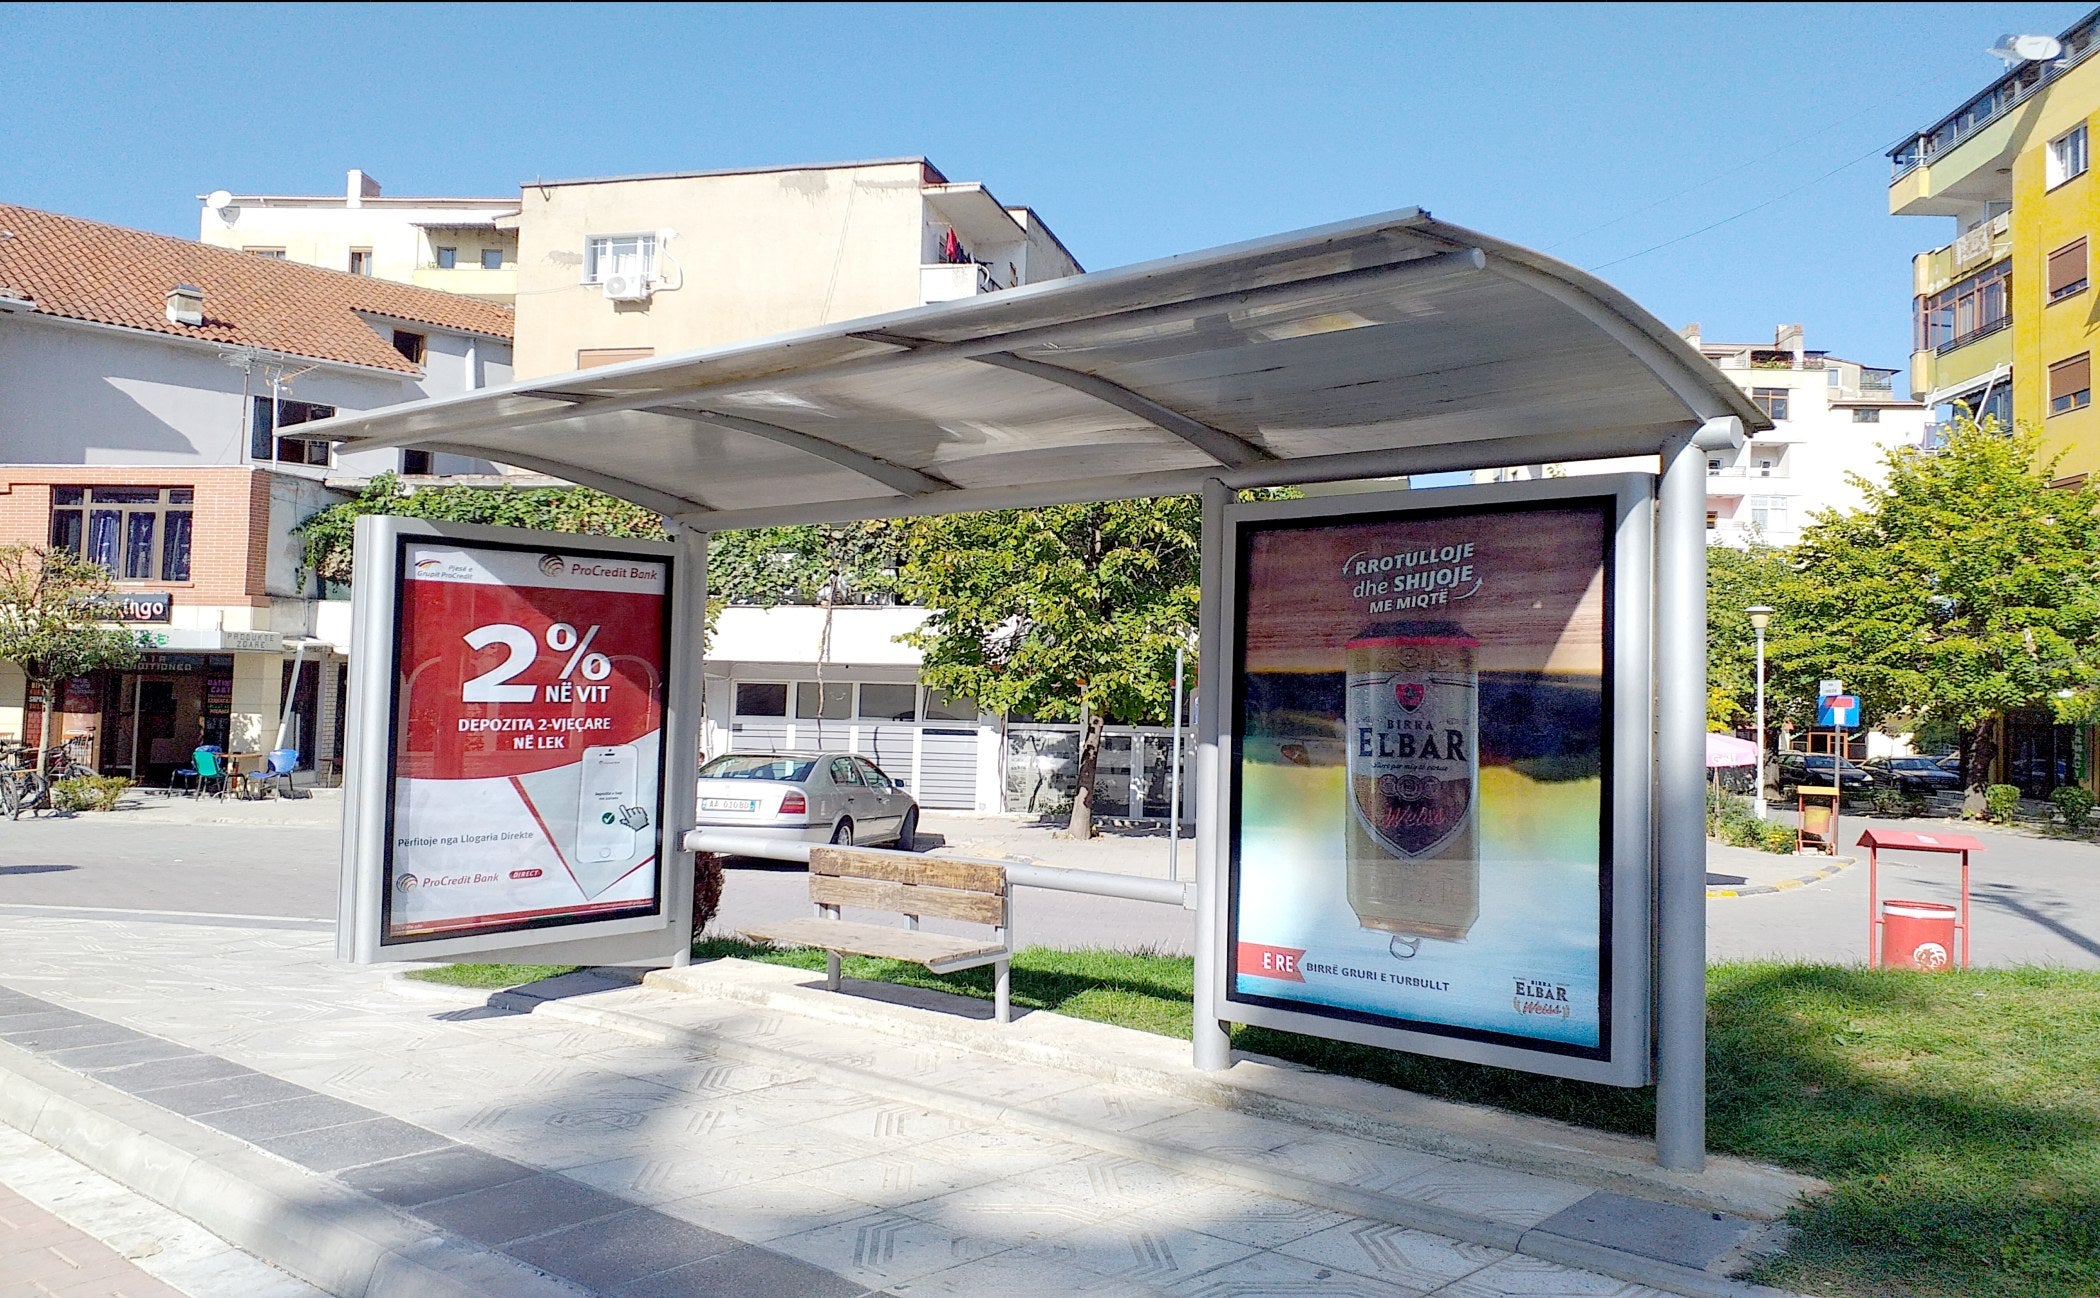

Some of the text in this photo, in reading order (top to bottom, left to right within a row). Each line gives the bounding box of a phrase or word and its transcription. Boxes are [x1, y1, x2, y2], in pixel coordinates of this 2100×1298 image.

[1354, 542, 1475, 576] RROTULLOJE
[441, 571, 473, 580] ProCredit
[571, 564, 658, 580] ProCredit Bank
[1353, 565, 1473, 598] dhe SHIJOJE
[1369, 589, 1449, 613] ME MIQTË
[545, 682, 610, 703] NË VIT
[458, 717, 611, 733] DEPOZITA 2-VJEÇARE
[1387, 719, 1434, 731] BIRRA
[513, 735, 565, 750] NË LEK
[1357, 727, 1467, 762] ELBAR
[398, 830, 534, 847] Përfitoje nga Llogaria Direkte
[422, 870, 541, 888] ProCredit Bank DIRECT
[1263, 952, 1294, 973] E RE
[1306, 961, 1450, 992] BIRRË GRURI E TURBULLT
[1515, 981, 1569, 1002] ELBAR
[1522, 1001, 1562, 1015] Weiss
